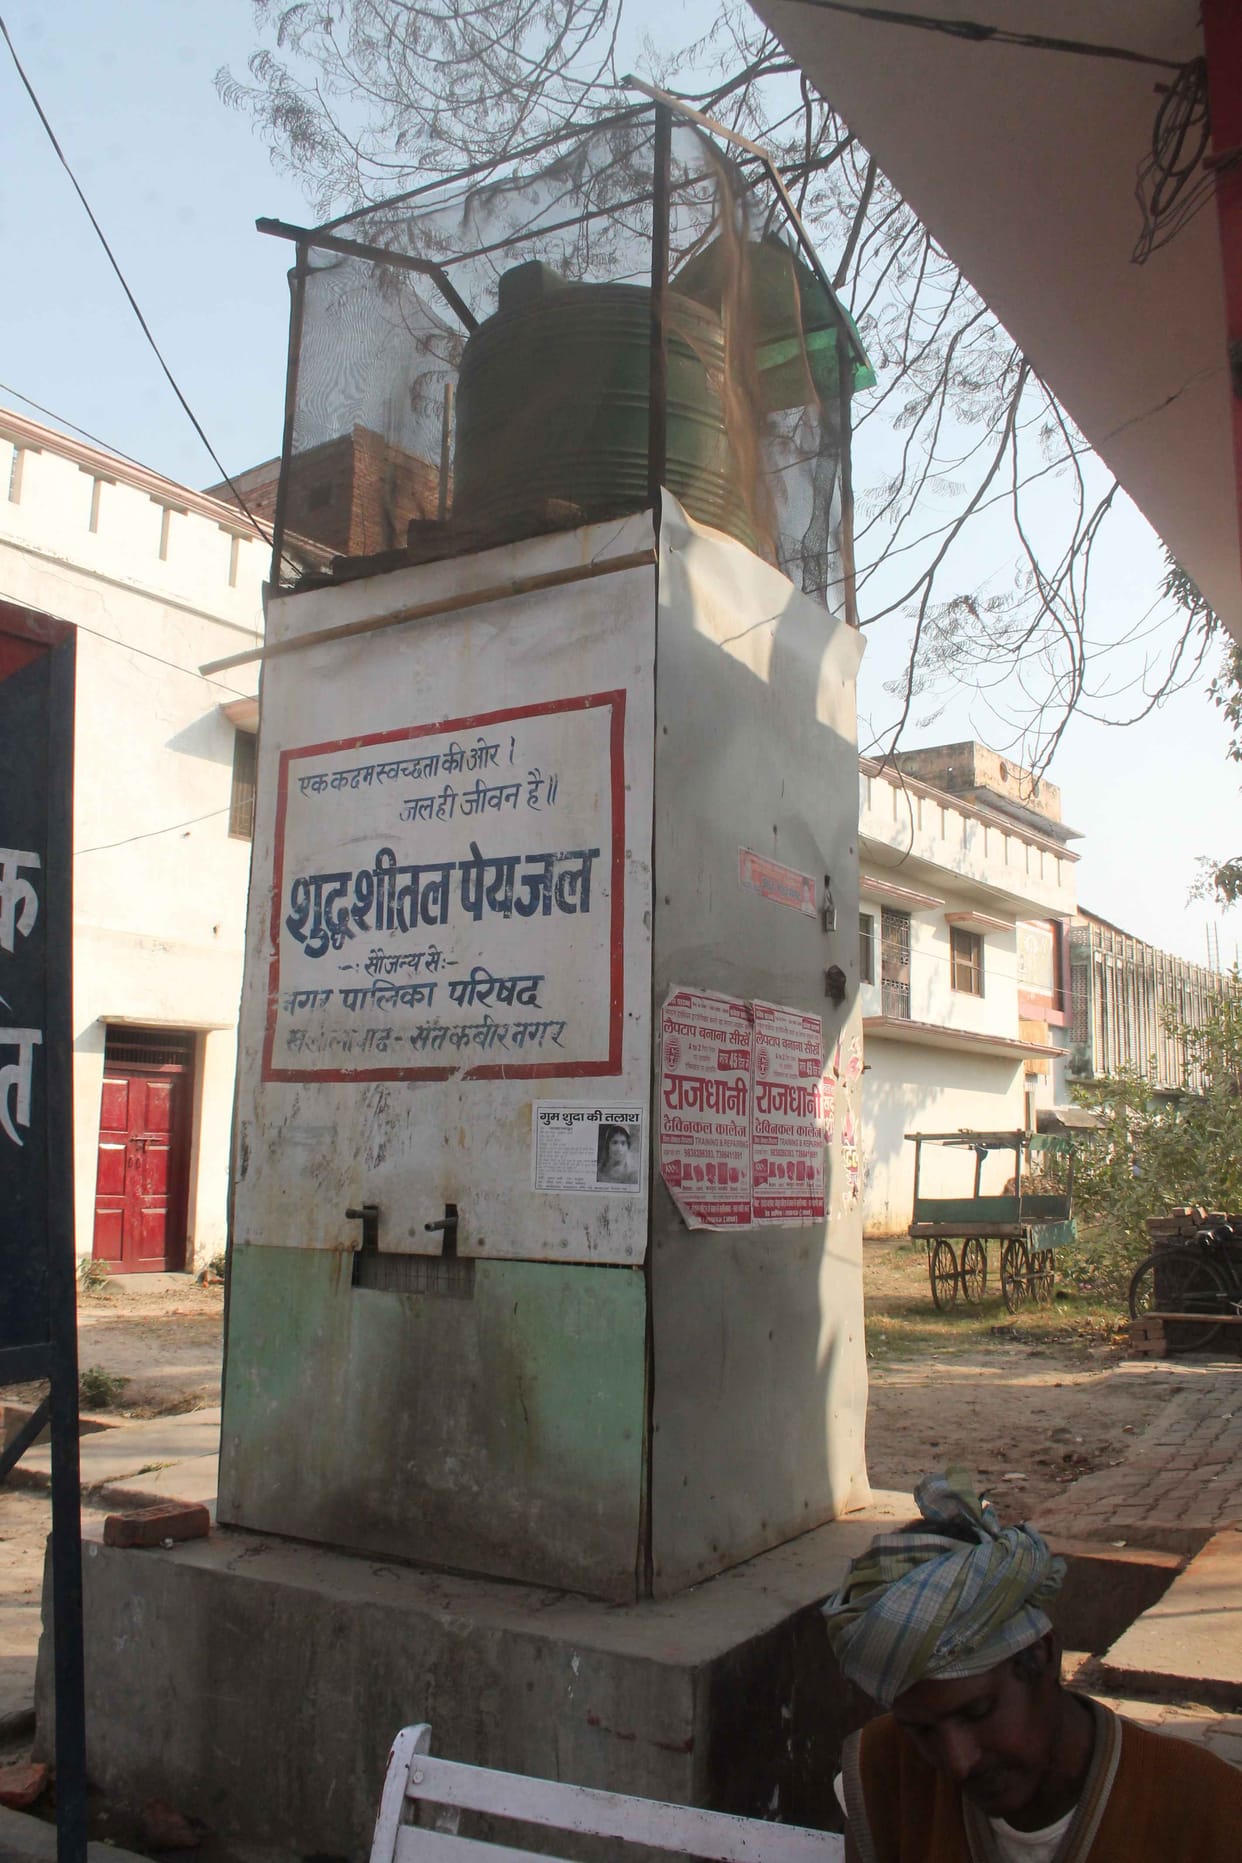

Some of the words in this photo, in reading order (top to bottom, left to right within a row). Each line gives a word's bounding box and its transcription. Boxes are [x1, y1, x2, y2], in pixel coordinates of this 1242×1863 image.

[460, 778, 522, 816] जीवन
[339, 979, 437, 1012] पालिका
[449, 966, 545, 1008] परिषद
[699, 1027, 727, 1043] बनाना
[664, 1073, 748, 1116] राजधानी
[756, 1081, 821, 1118] राजधानी
[540, 1112, 560, 1125] गुम
[563, 1113, 584, 1126] शुदा
[587, 1110, 602, 1122] की
[605, 1113, 639, 1122] तलाश
